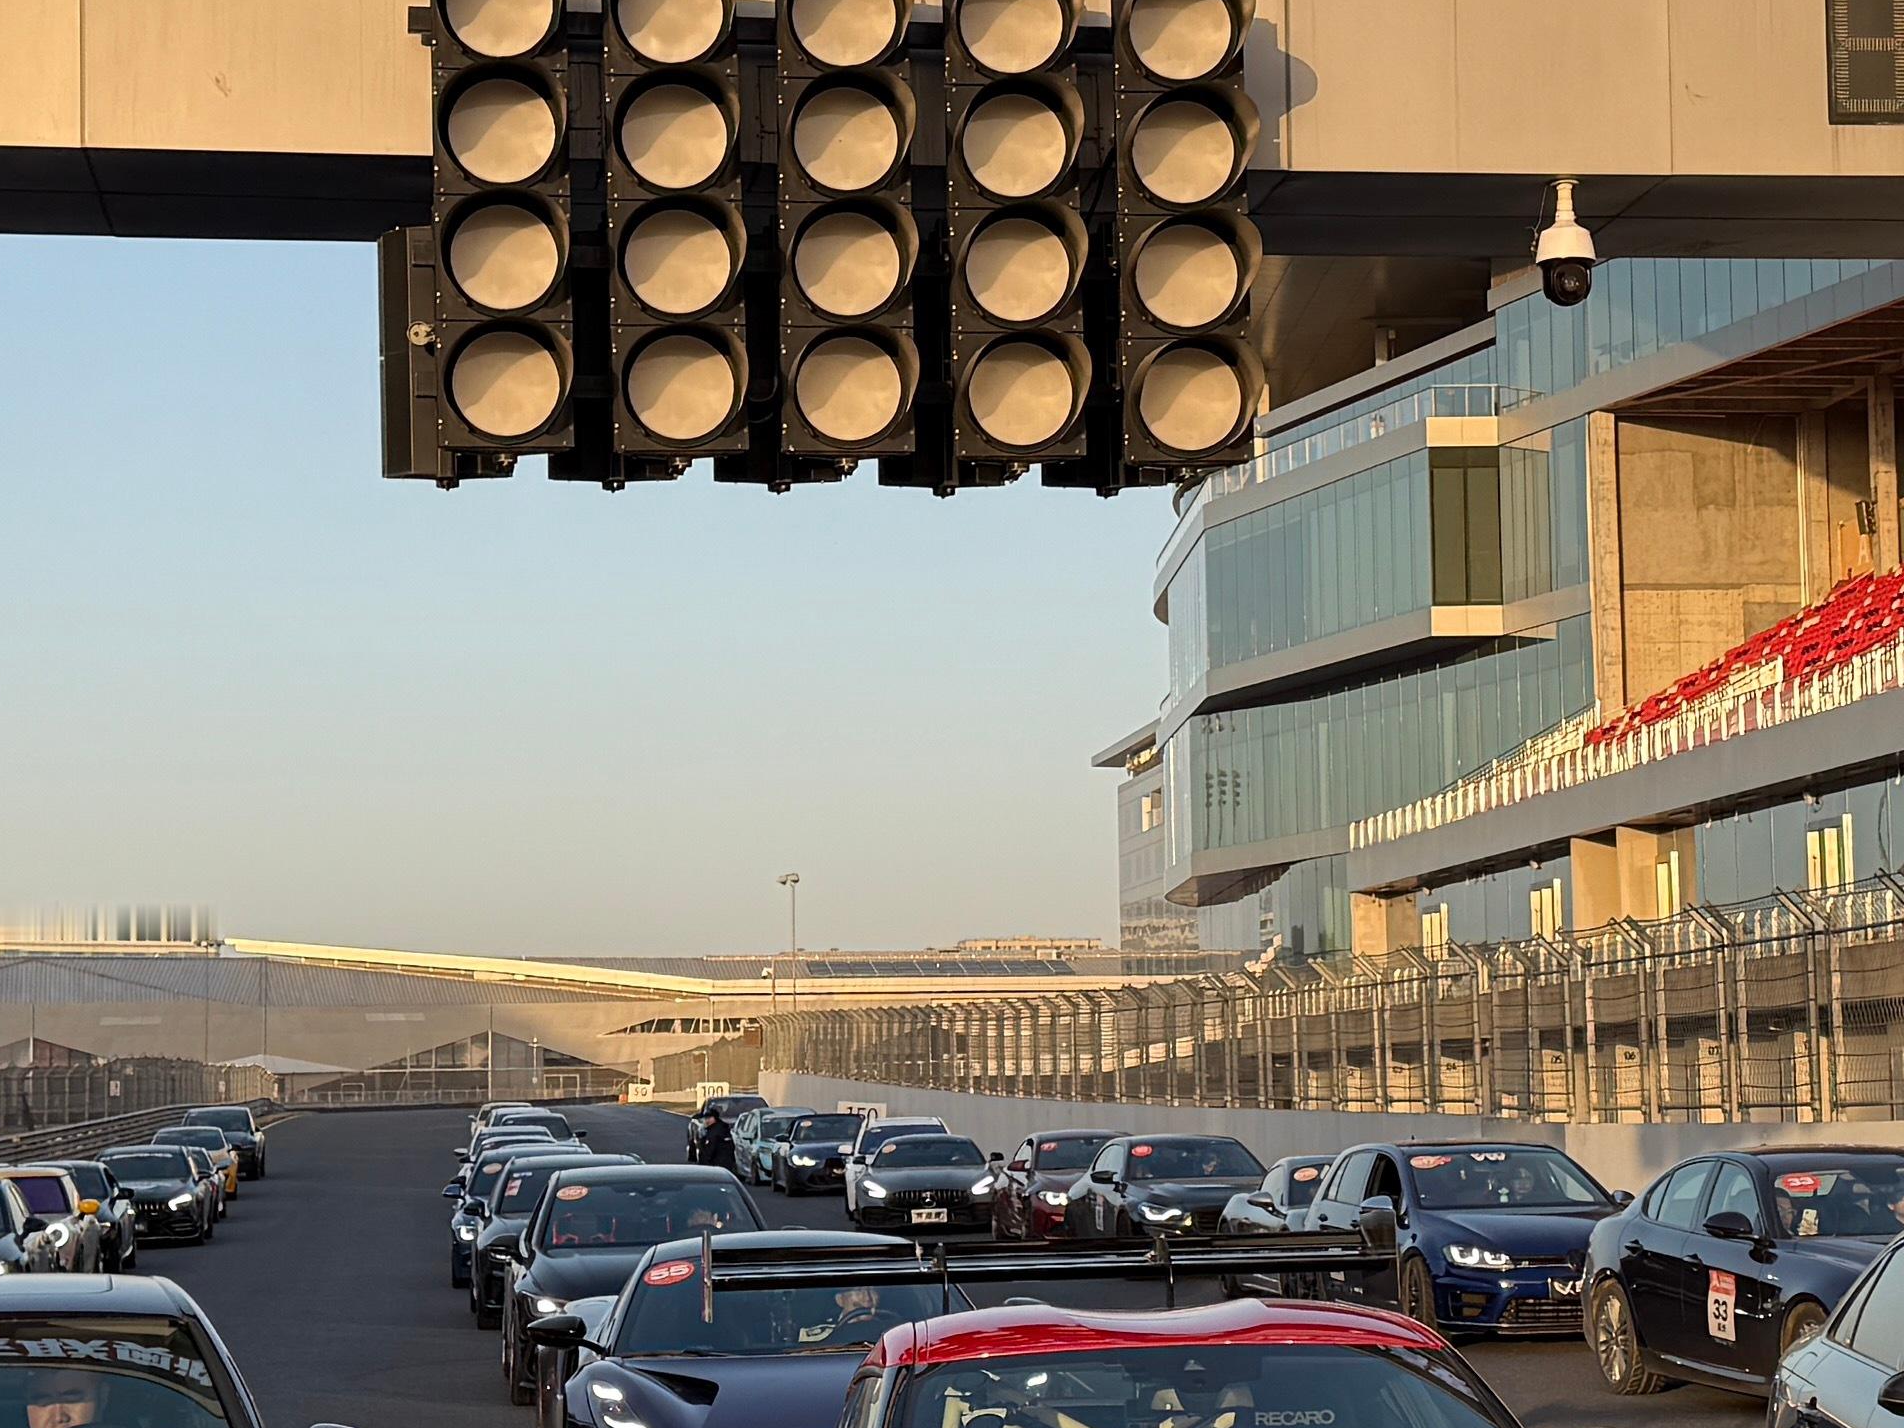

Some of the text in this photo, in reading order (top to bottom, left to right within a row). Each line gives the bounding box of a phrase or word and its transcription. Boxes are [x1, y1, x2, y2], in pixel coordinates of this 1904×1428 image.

[700, 1085, 723, 1098] 100
[650, 1264, 690, 1281] 55
[1712, 1298, 1728, 1322] 33
[1255, 1409, 1335, 1426] RECARO
